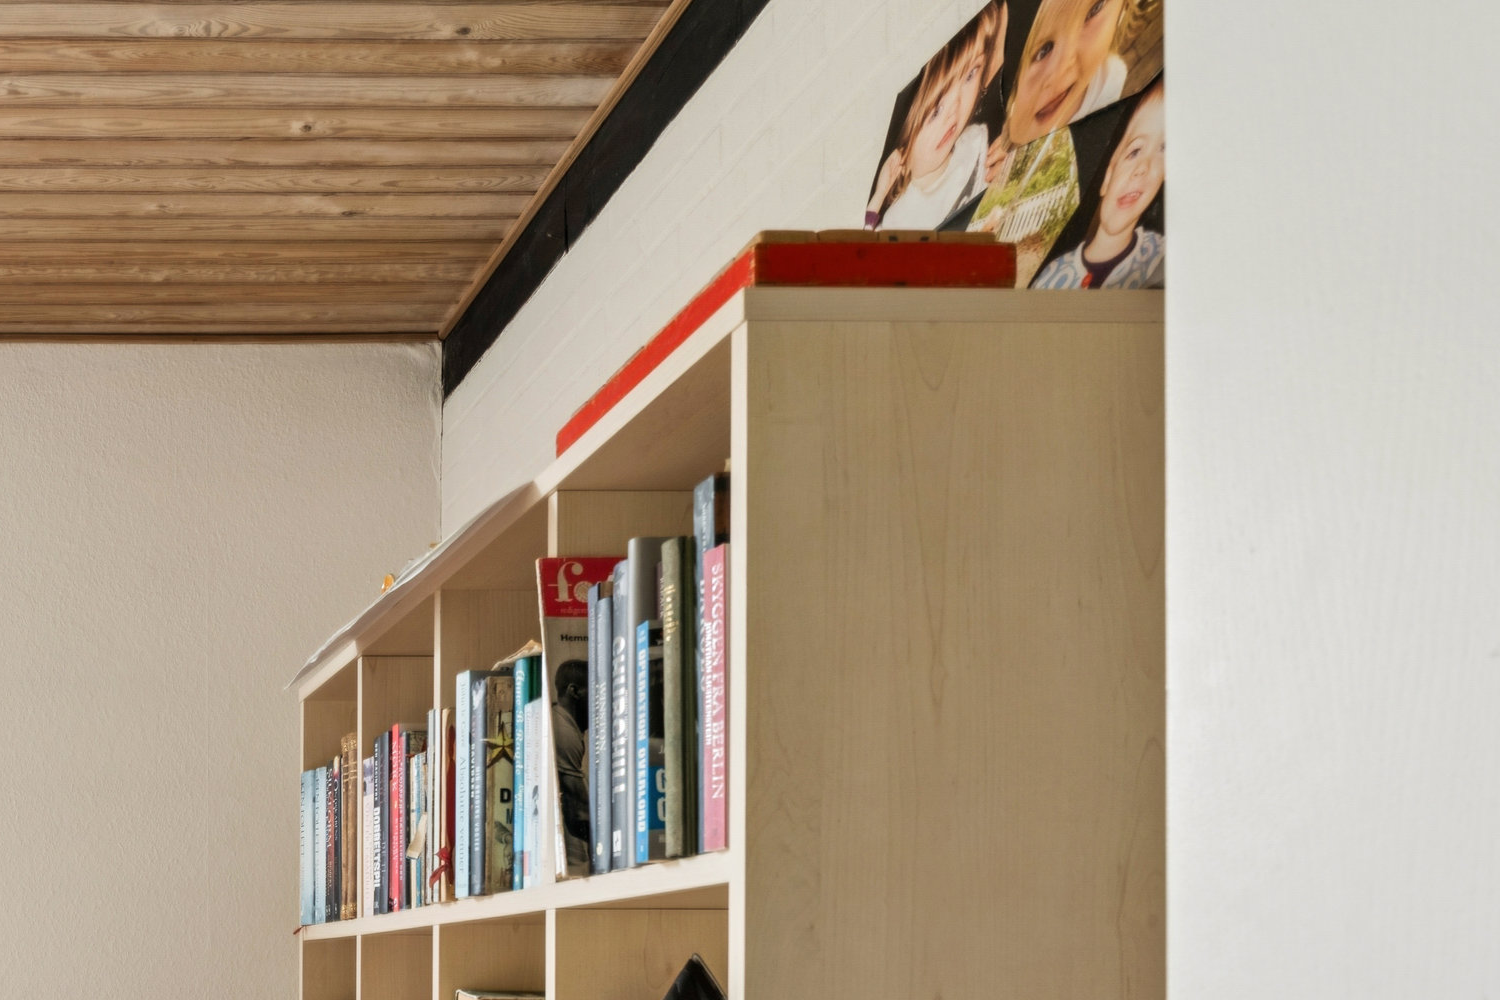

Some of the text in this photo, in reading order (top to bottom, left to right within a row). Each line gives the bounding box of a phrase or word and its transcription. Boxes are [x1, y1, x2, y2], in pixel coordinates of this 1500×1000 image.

[515, 670, 526, 706] Anne
[598, 681, 607, 751] WINSTON
[612, 636, 626, 793] CHURCHILL
[637, 648, 647, 741] OPERATION
[711, 562, 725, 799] SKYGGEN FRA BERLIN
[513, 729, 524, 777] Ragde
[637, 747, 647, 832] OVERLORD
[500, 788, 512, 803] D
[373, 806, 381, 890] DOBBELTSPIL
